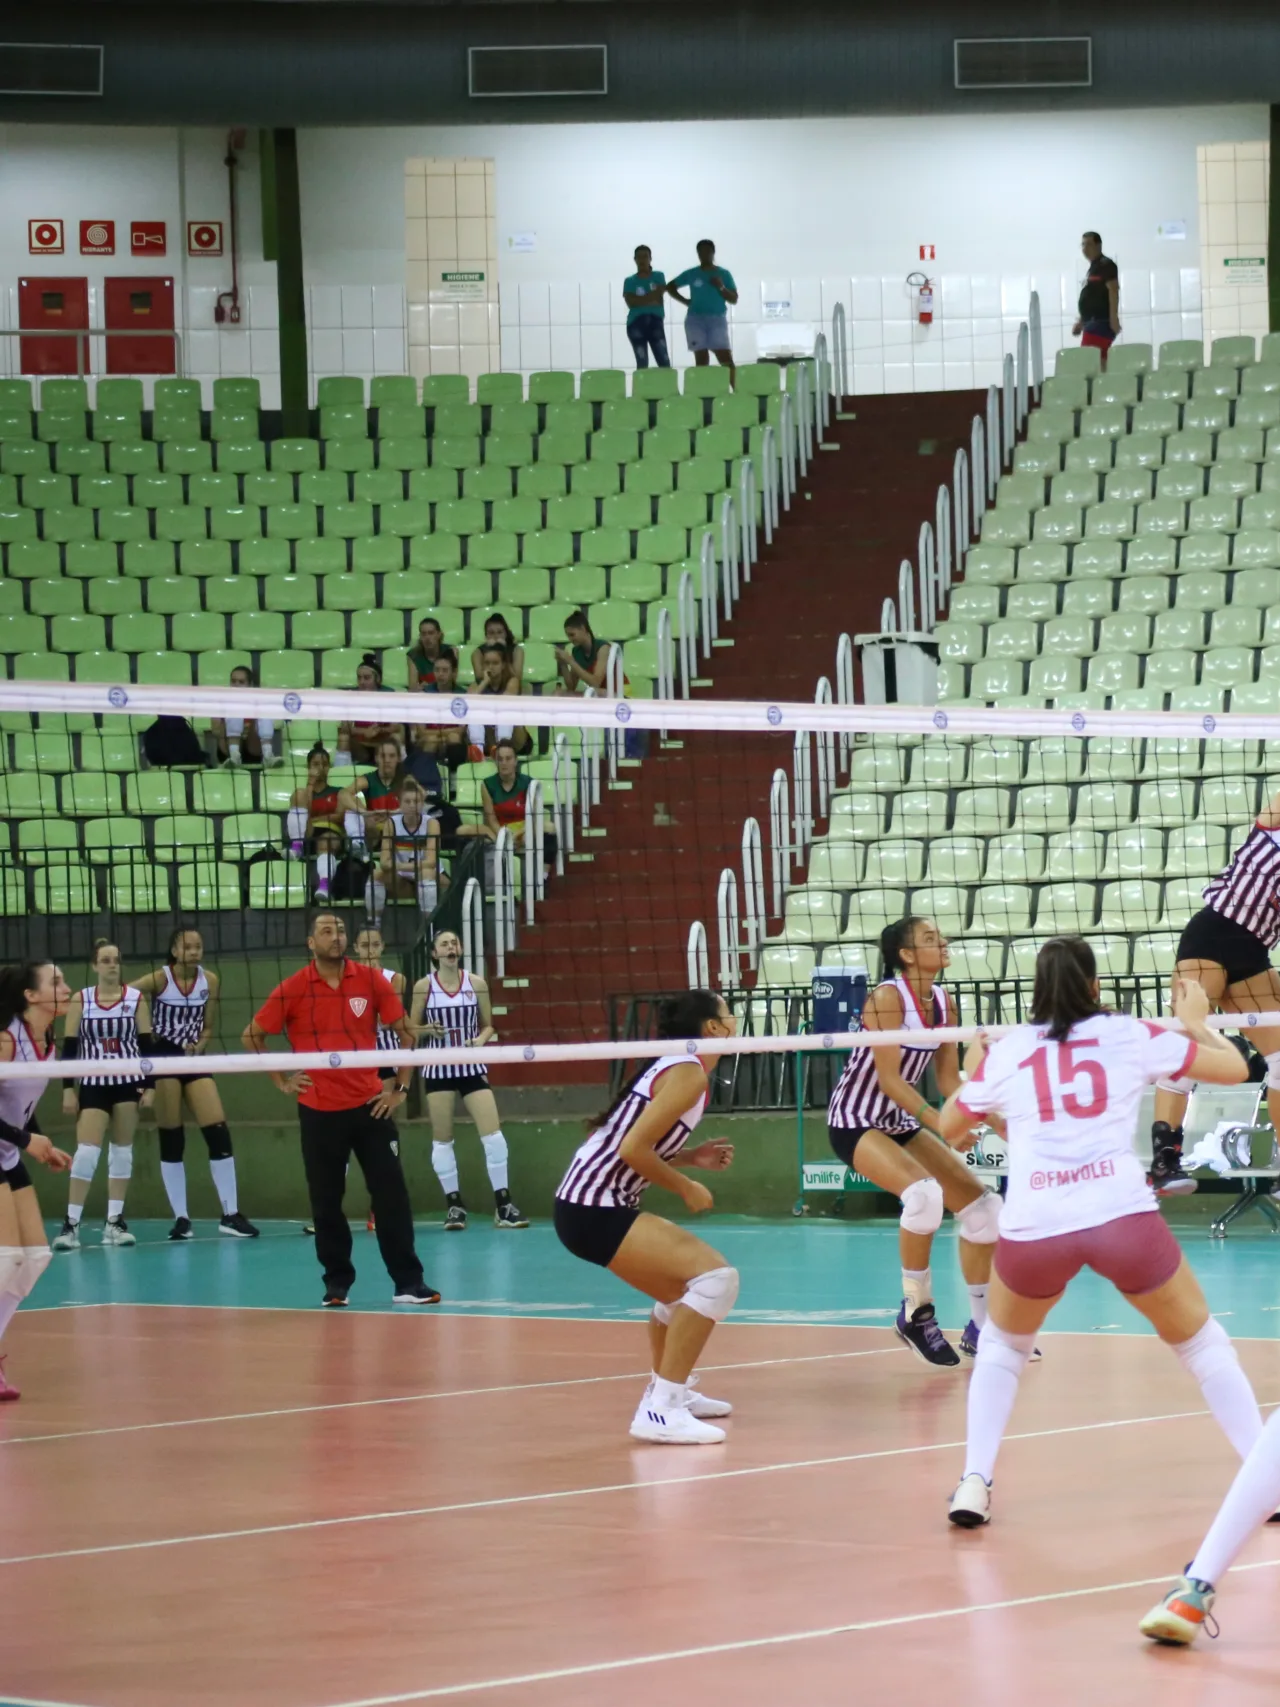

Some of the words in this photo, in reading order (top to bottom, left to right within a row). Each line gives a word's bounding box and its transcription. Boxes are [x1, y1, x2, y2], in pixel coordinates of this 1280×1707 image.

[447, 273, 481, 281] HIGIENE
[1018, 1038, 1109, 1123] 15
[805, 1170, 841, 1184] unilife
[1029, 1159, 1115, 1191] @FMVOLEI
